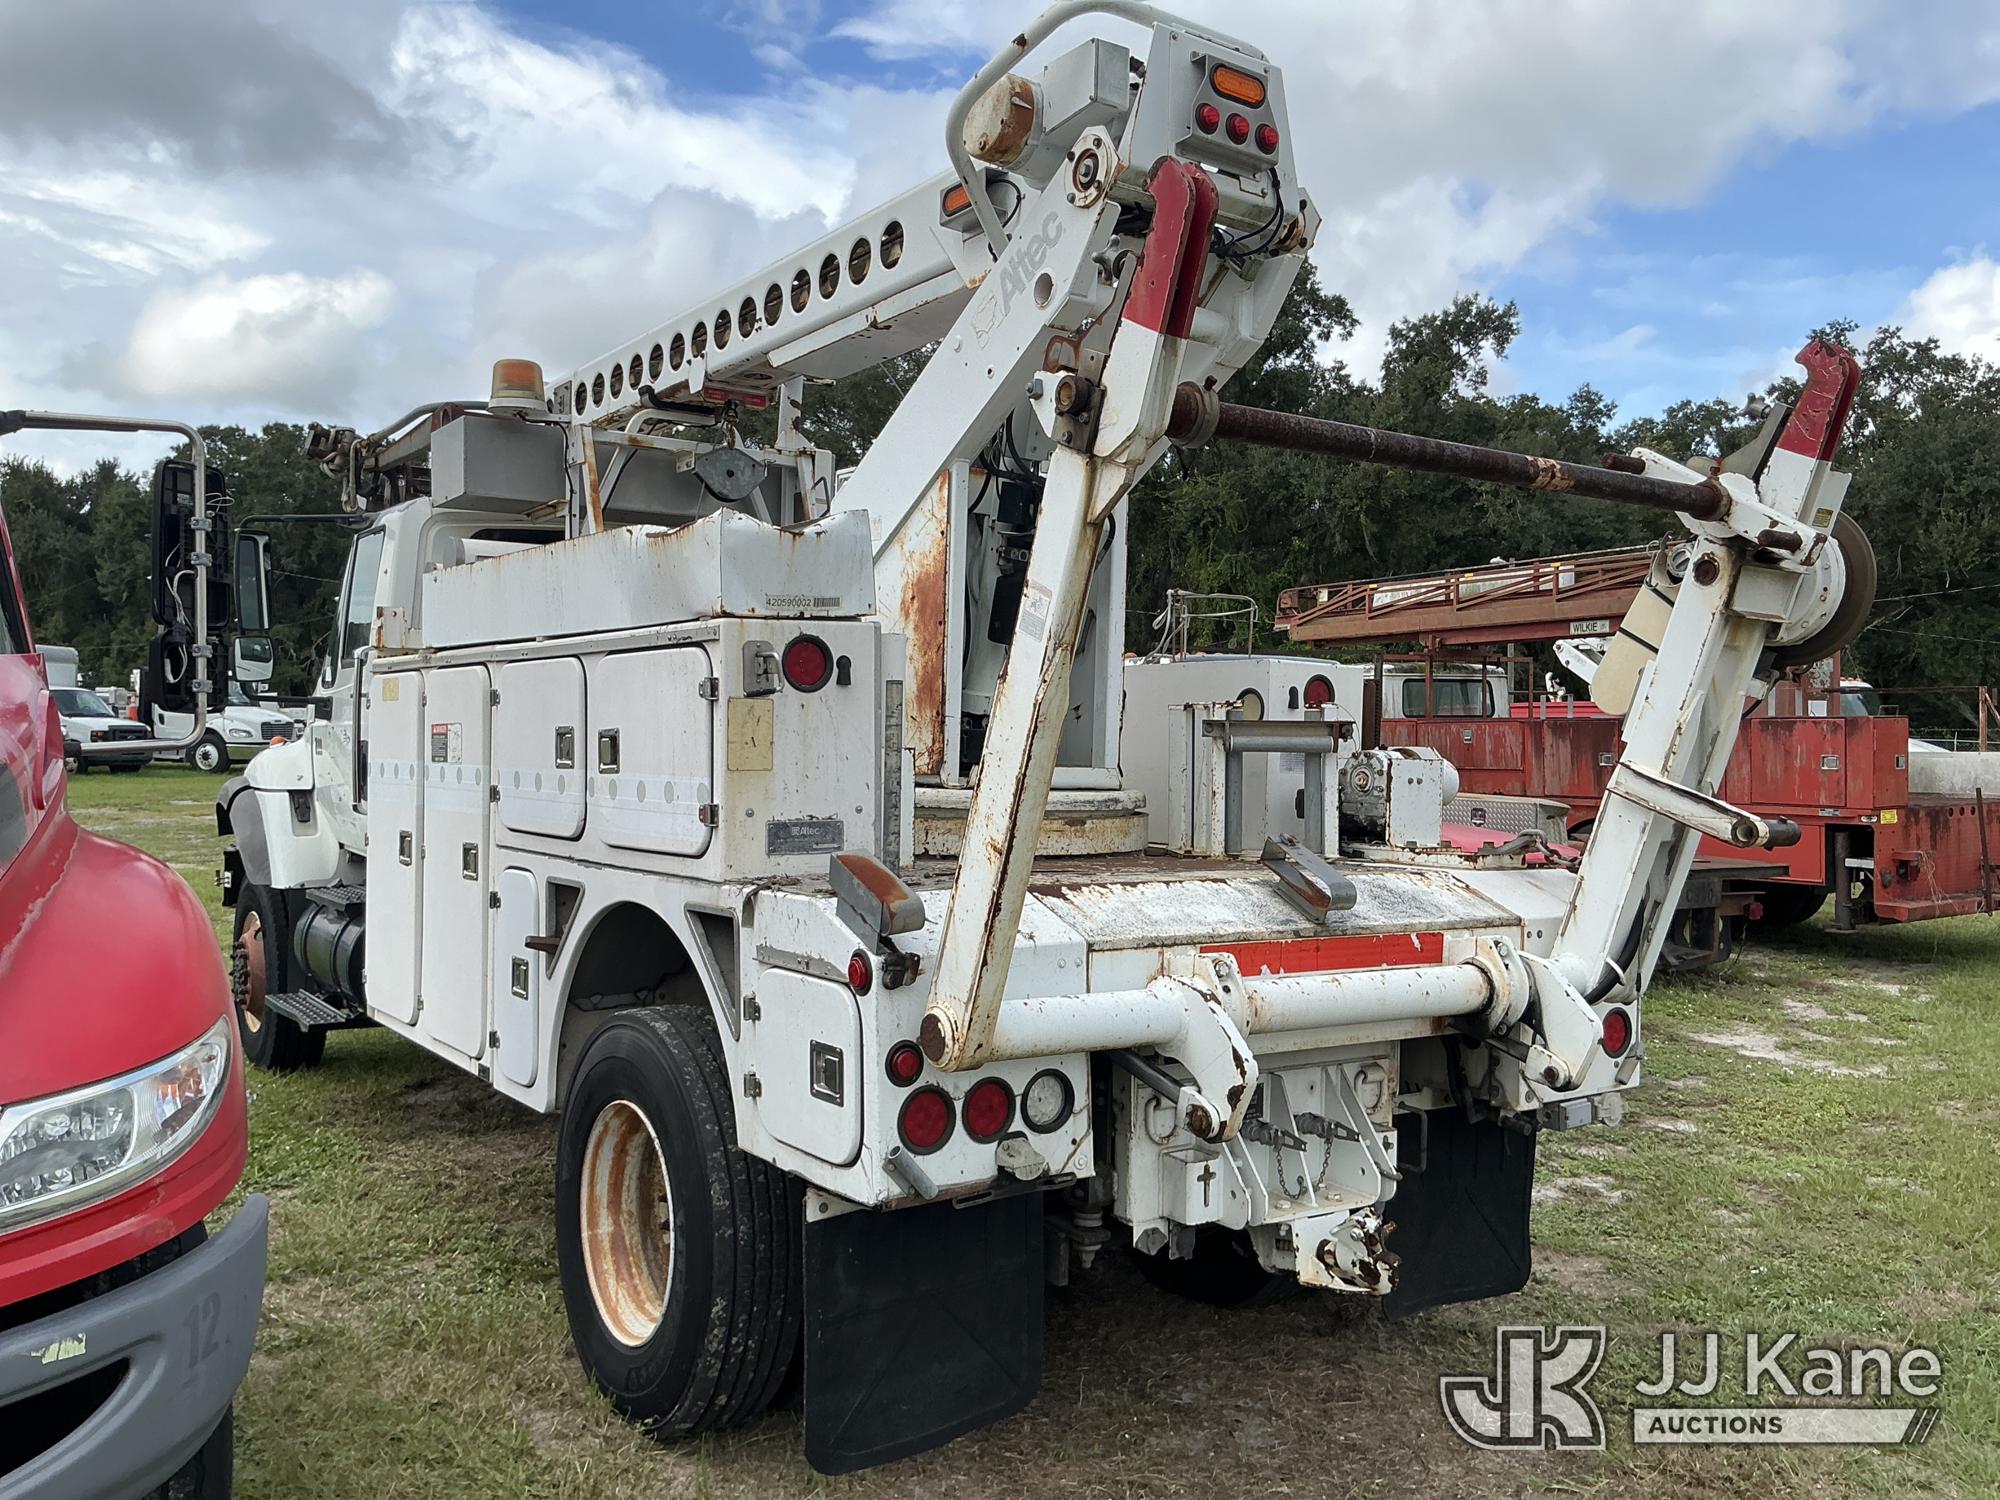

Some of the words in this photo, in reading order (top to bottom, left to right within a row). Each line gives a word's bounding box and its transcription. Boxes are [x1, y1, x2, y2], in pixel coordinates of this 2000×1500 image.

[1000, 211, 1063, 317] Altec
[767, 597, 811, 607] 420590002
[1572, 622, 1597, 632] WILKIE
[182, 1291, 221, 1369] 12
